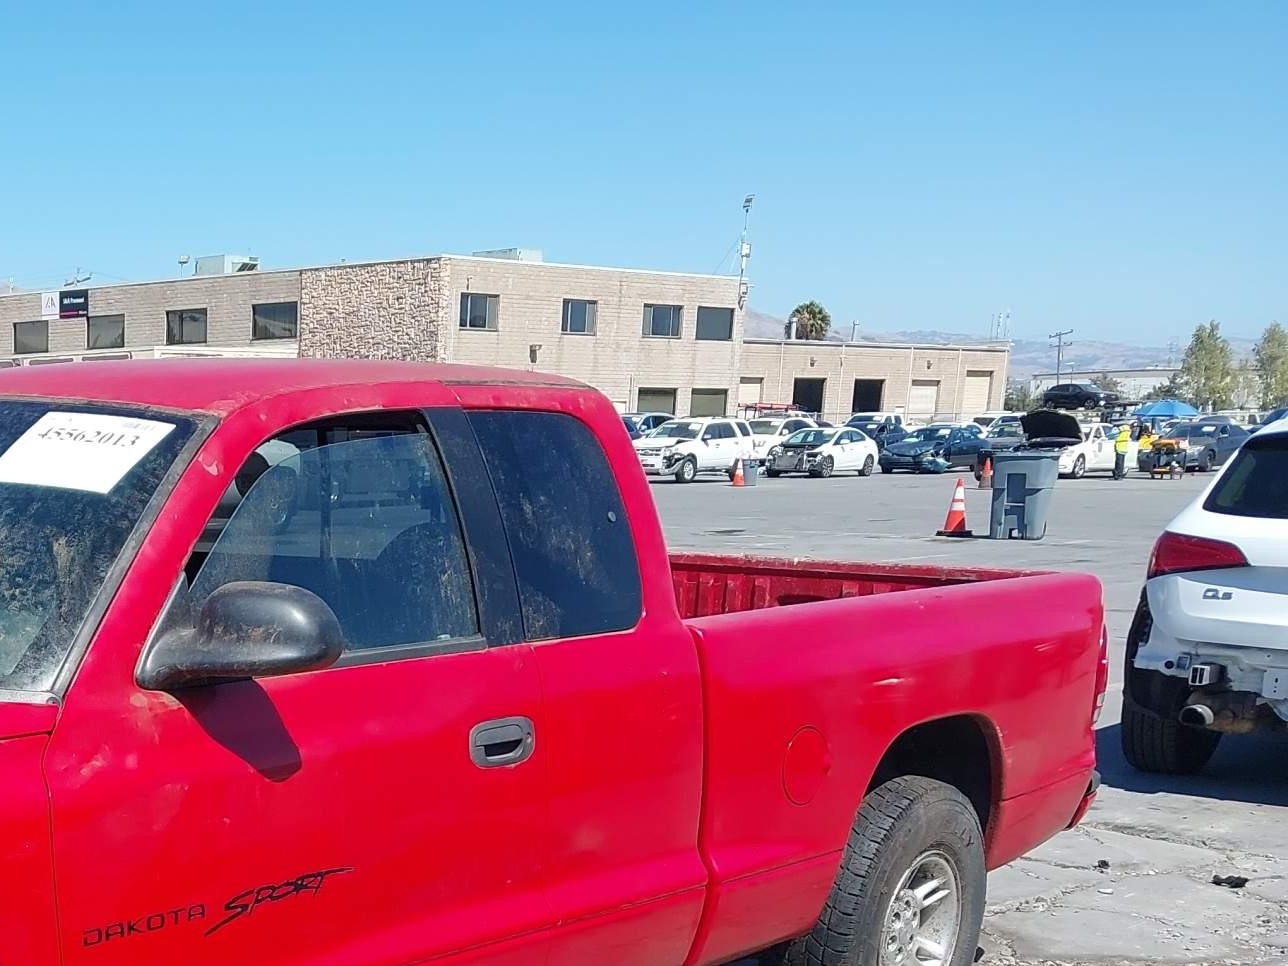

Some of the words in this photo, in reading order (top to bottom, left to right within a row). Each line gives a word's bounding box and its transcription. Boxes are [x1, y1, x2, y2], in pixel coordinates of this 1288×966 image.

[38, 427, 140, 447] 45562013
[83, 903, 206, 947] DAKOTA
[204, 866, 354, 937] SPORT
